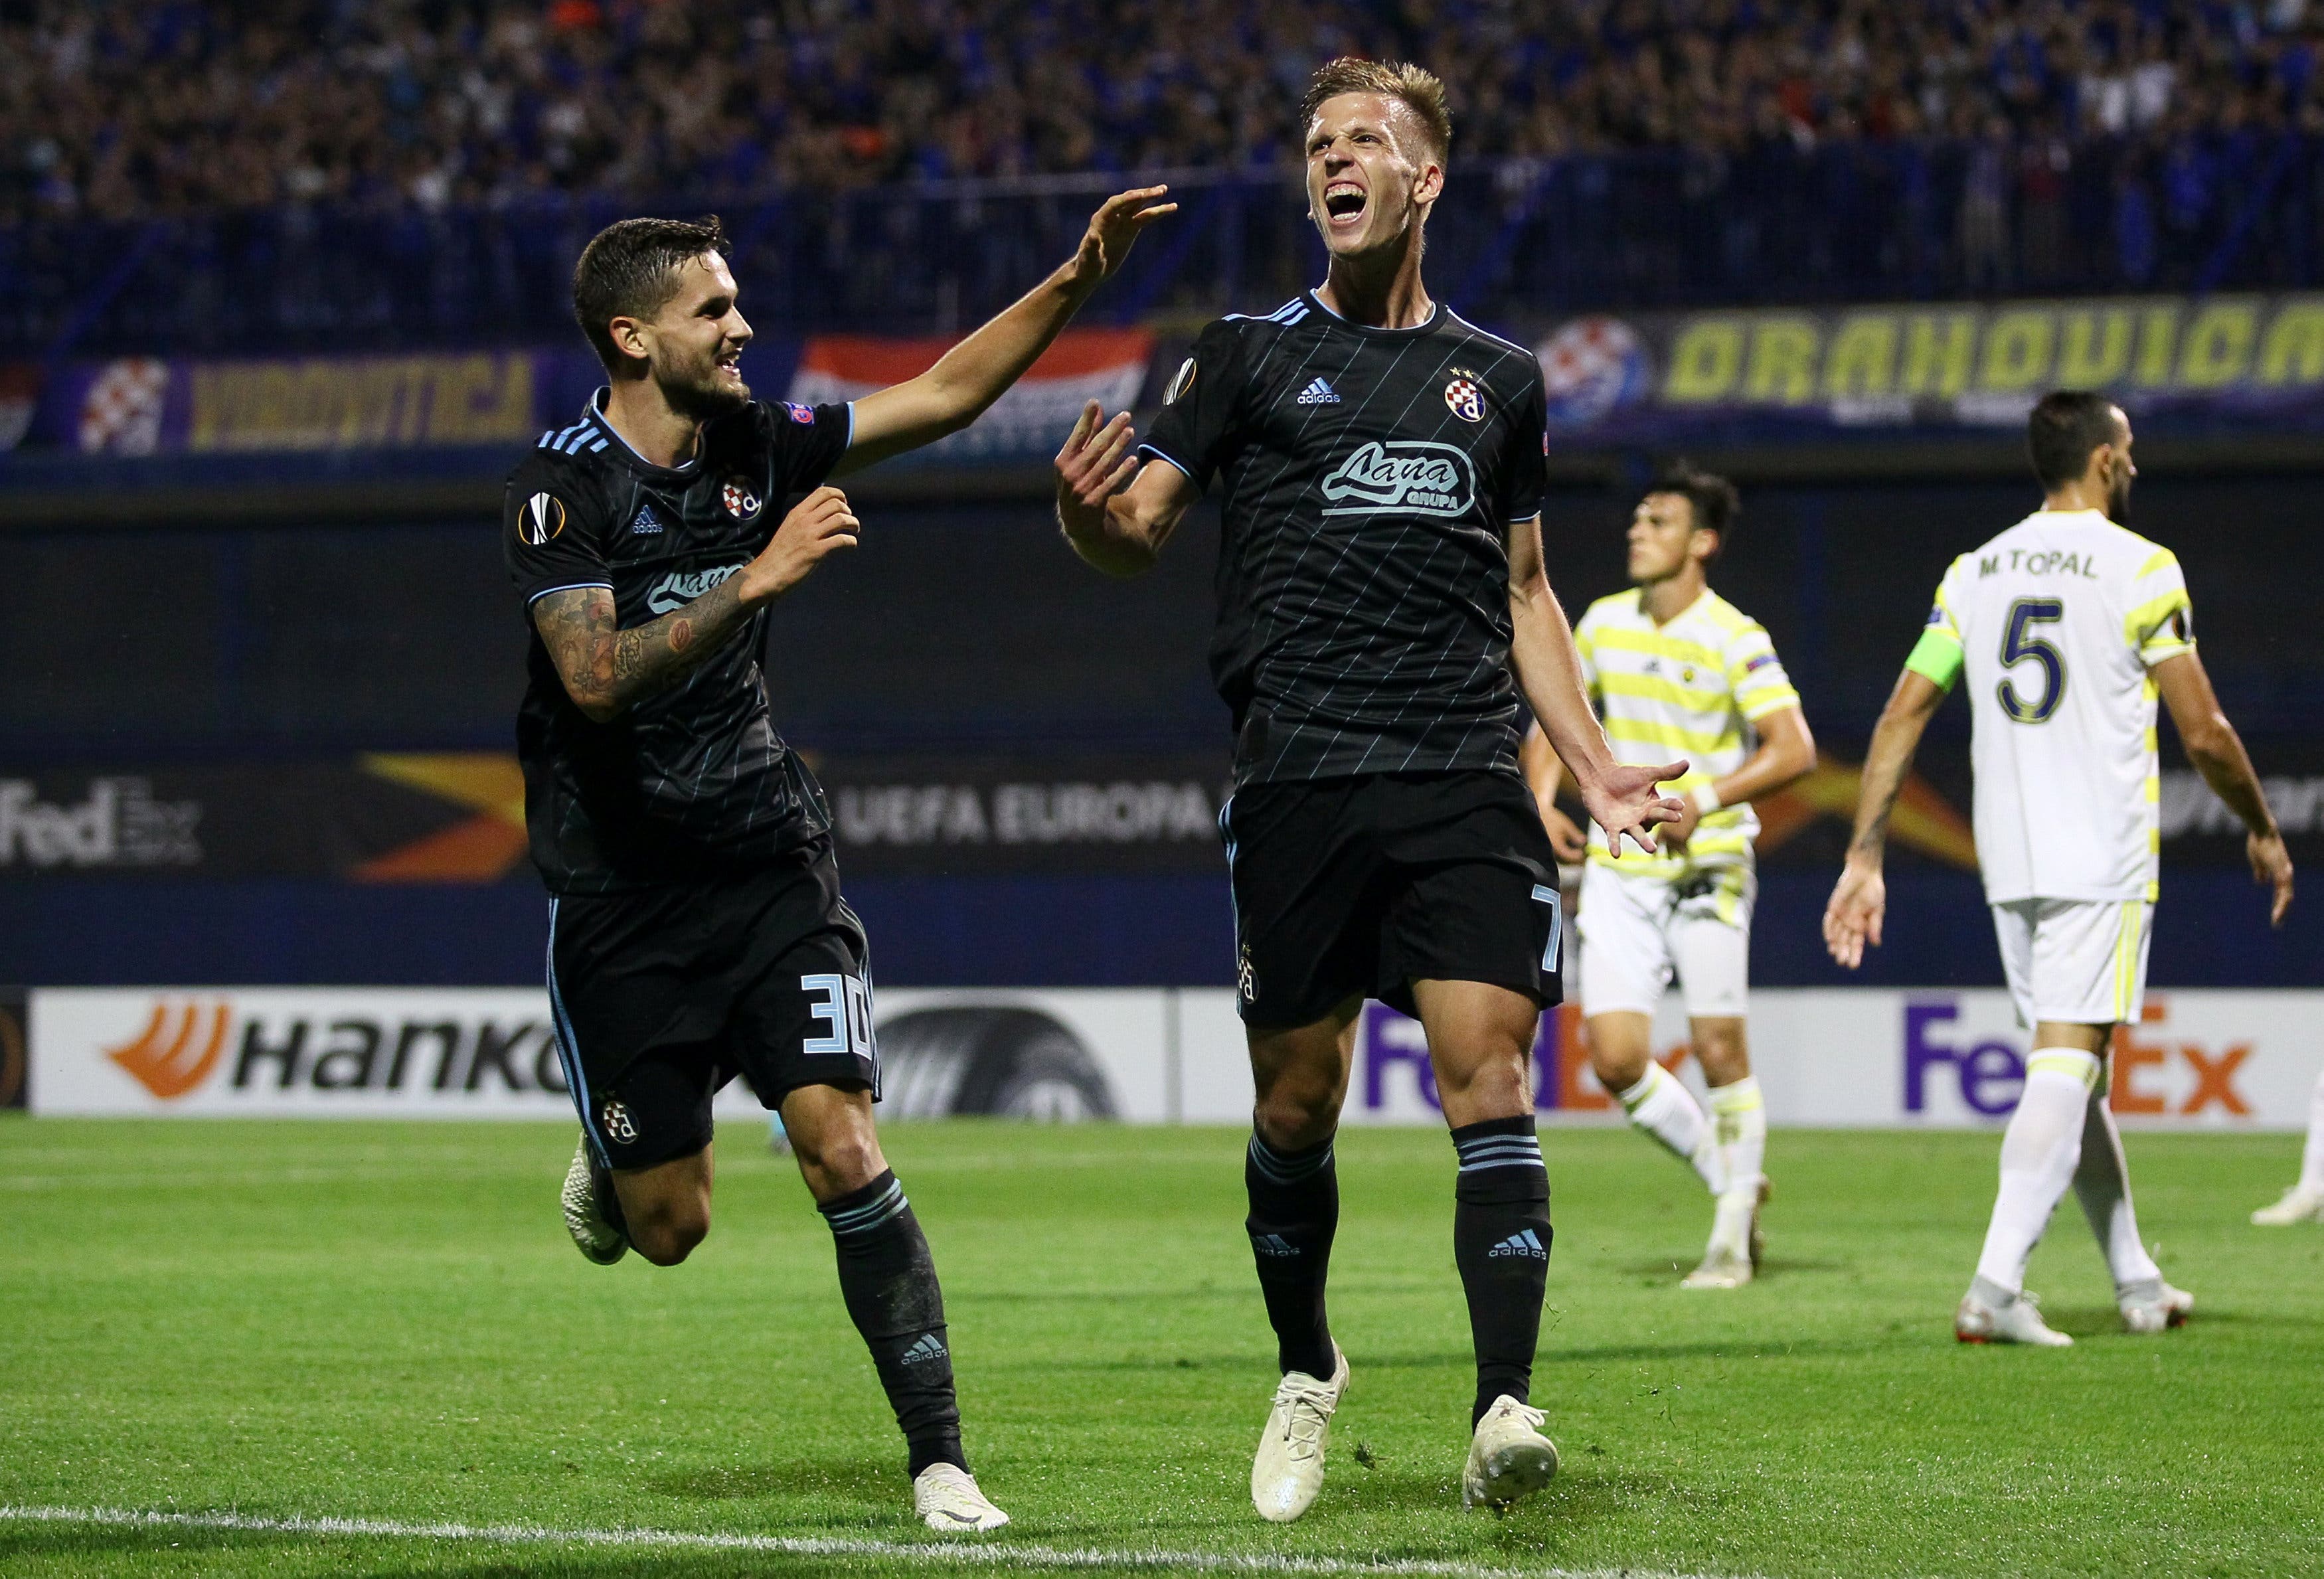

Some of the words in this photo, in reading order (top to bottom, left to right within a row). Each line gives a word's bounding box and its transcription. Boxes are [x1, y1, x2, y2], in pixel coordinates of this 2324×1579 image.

[1297, 393, 1341, 404] adidas
[1406, 492, 1459, 509] GRUPA
[632, 524, 663, 534] adidas
[2010, 549, 2098, 579] TOPAL
[647, 563, 744, 615] Lan
[1997, 598, 2067, 724] 5
[837, 784, 987, 846] UEFA
[994, 781, 1219, 845] EUROPA
[1531, 884, 1562, 973] 7
[801, 973, 872, 1062] 30
[1904, 1004, 2252, 1116] FeEx
[1489, 1246, 1547, 1260] adidas
[901, 1349, 948, 1365] adidas
